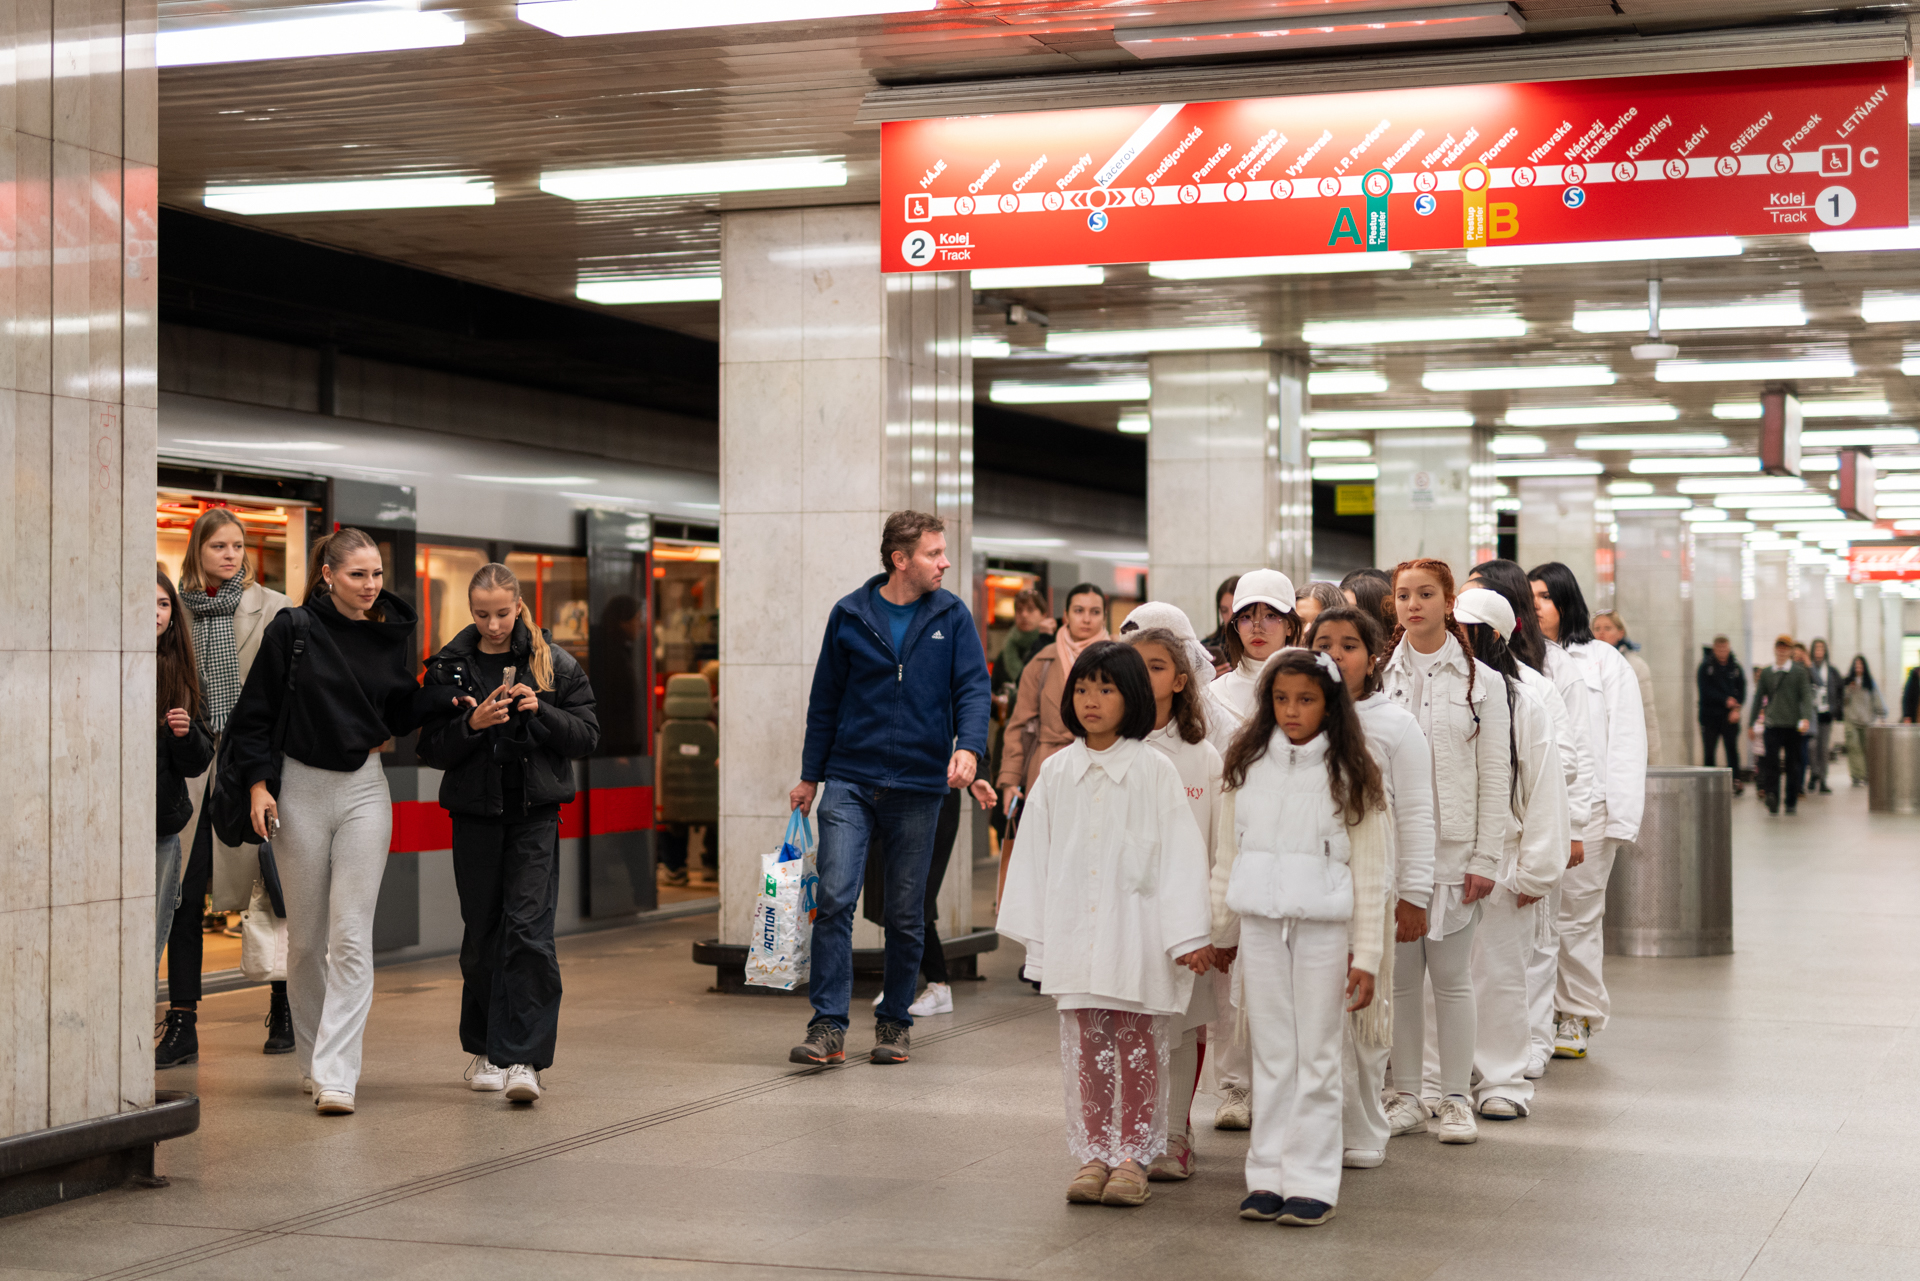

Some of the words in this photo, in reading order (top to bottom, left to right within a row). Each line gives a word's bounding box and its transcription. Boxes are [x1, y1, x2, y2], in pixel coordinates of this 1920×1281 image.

[1782, 112, 1822, 151] Prosek
[1836, 85, 1890, 139] LETŇANY
[1340, 156, 1353, 170] P.
[1349, 119, 1391, 159] Pavlova
[1382, 128, 1425, 171] Muzeum
[1421, 132, 1456, 169] Hlavní
[1441, 126, 1479, 168] nádraží
[1478, 127, 1518, 166] Florenc
[1527, 120, 1573, 164] Vltavská
[1563, 119, 1605, 161] Nádraží
[1581, 107, 1638, 162] Holešovice
[1626, 114, 1673, 159] Kobylisy
[1677, 124, 1710, 157] Ládví
[1729, 111, 1774, 154] Střížkov
[1012, 153, 1048, 192] Chodov
[1056, 152, 1092, 190] Roztyly
[1098, 147, 1136, 187] Kačerov
[1146, 125, 1203, 186] Budějovická
[1192, 142, 1232, 183] Pankrác
[1227, 129, 1278, 180] Pražského
[1247, 132, 1289, 180] povstání
[1285, 129, 1333, 177] Vyšehrad
[1859, 147, 1879, 168] C
[919, 158, 948, 189] HÁJE
[967, 158, 1001, 194] Opatov
[1770, 192, 1806, 207] Kolej
[1770, 210, 1808, 223] Track
[1827, 193, 1840, 218] 1
[939, 232, 970, 246] Kolej
[1327, 206, 1363, 246] A
[1368, 211, 1379, 245] Přestup
[1378, 211, 1387, 245] Transfer
[1466, 206, 1476, 241] Přestup
[1475, 206, 1484, 240] Transfer
[1488, 202, 1520, 240] B
[911, 238, 926, 259] 2
[939, 249, 971, 261] Track
[764, 906, 775, 952] ACTION
